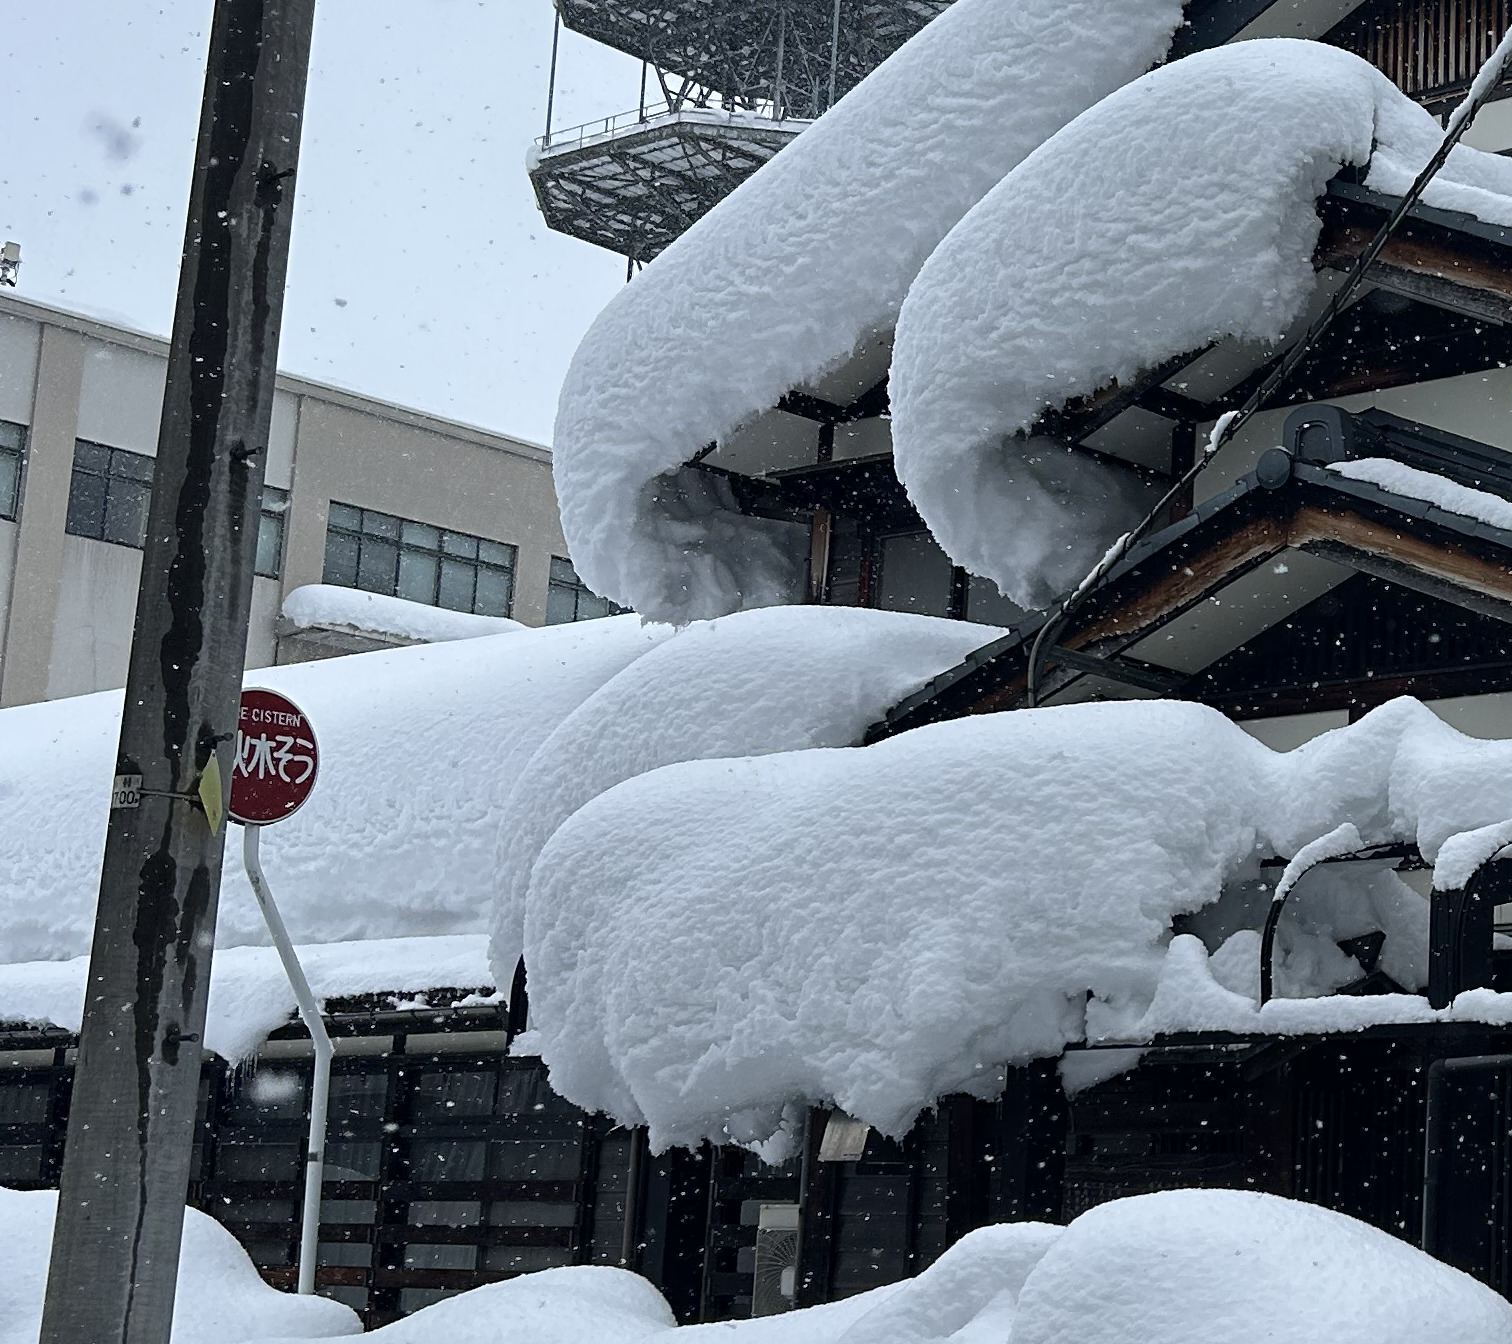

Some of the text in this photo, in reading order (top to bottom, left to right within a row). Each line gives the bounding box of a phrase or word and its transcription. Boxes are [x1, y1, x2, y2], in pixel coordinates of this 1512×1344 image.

[252, 708, 301, 727] CISTERN
[233, 729, 313, 784] 火水そう
